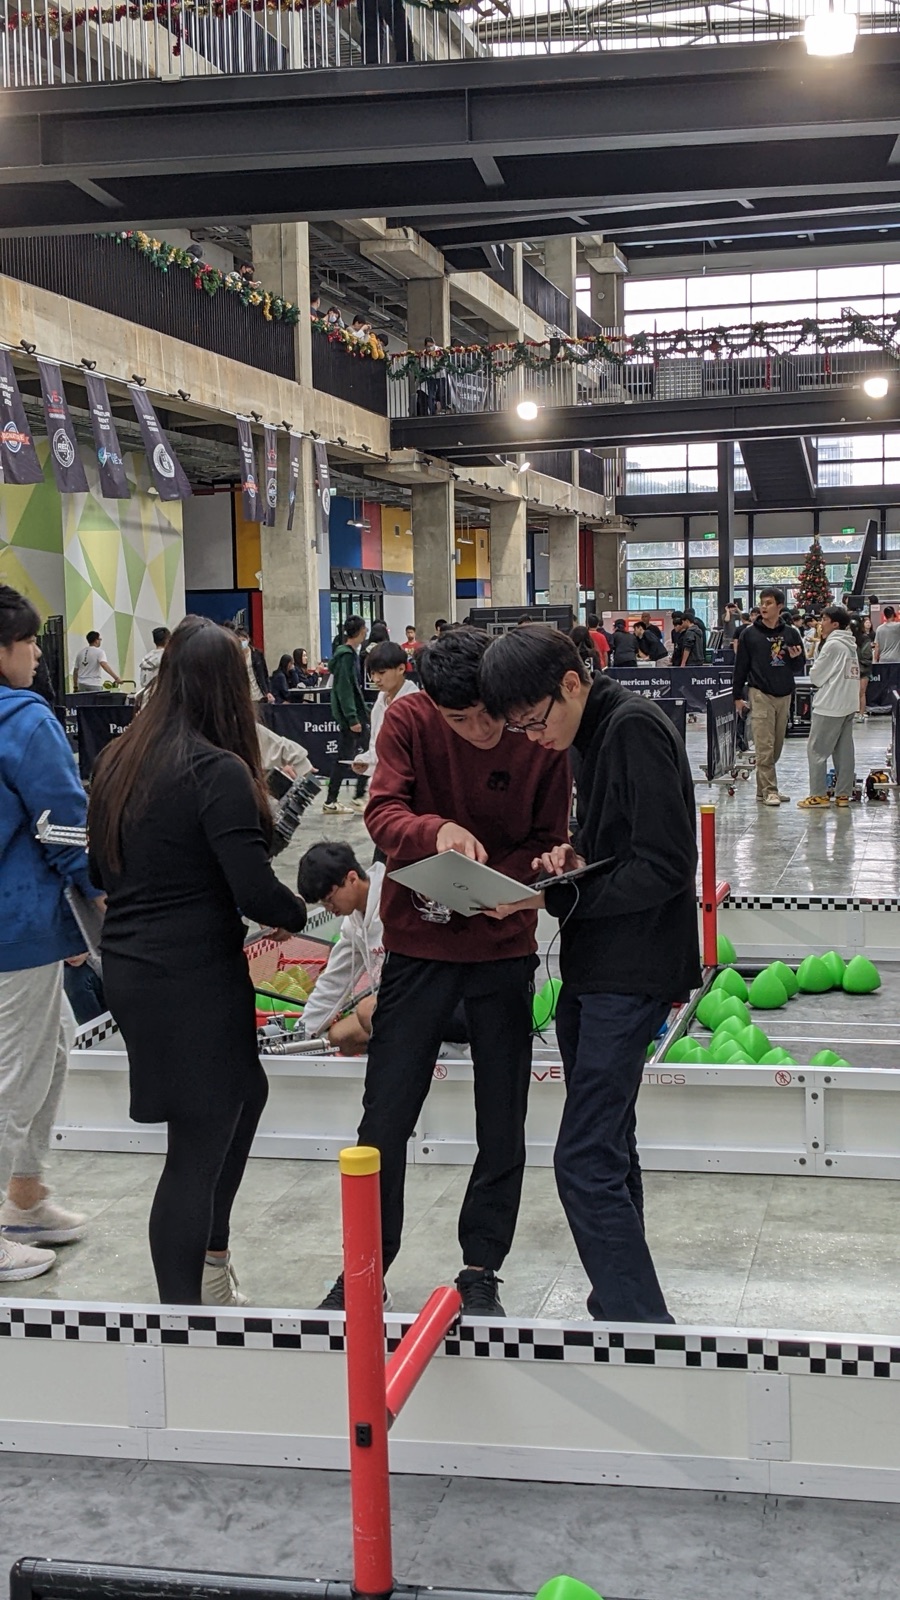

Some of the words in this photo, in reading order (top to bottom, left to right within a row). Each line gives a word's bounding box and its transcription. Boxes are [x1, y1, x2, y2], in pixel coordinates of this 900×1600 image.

[691, 677, 717, 685] Pacific
[109, 723, 129, 734] Pac
[304, 721, 341, 732] Pacific
[531, 1066, 566, 1082] VE
